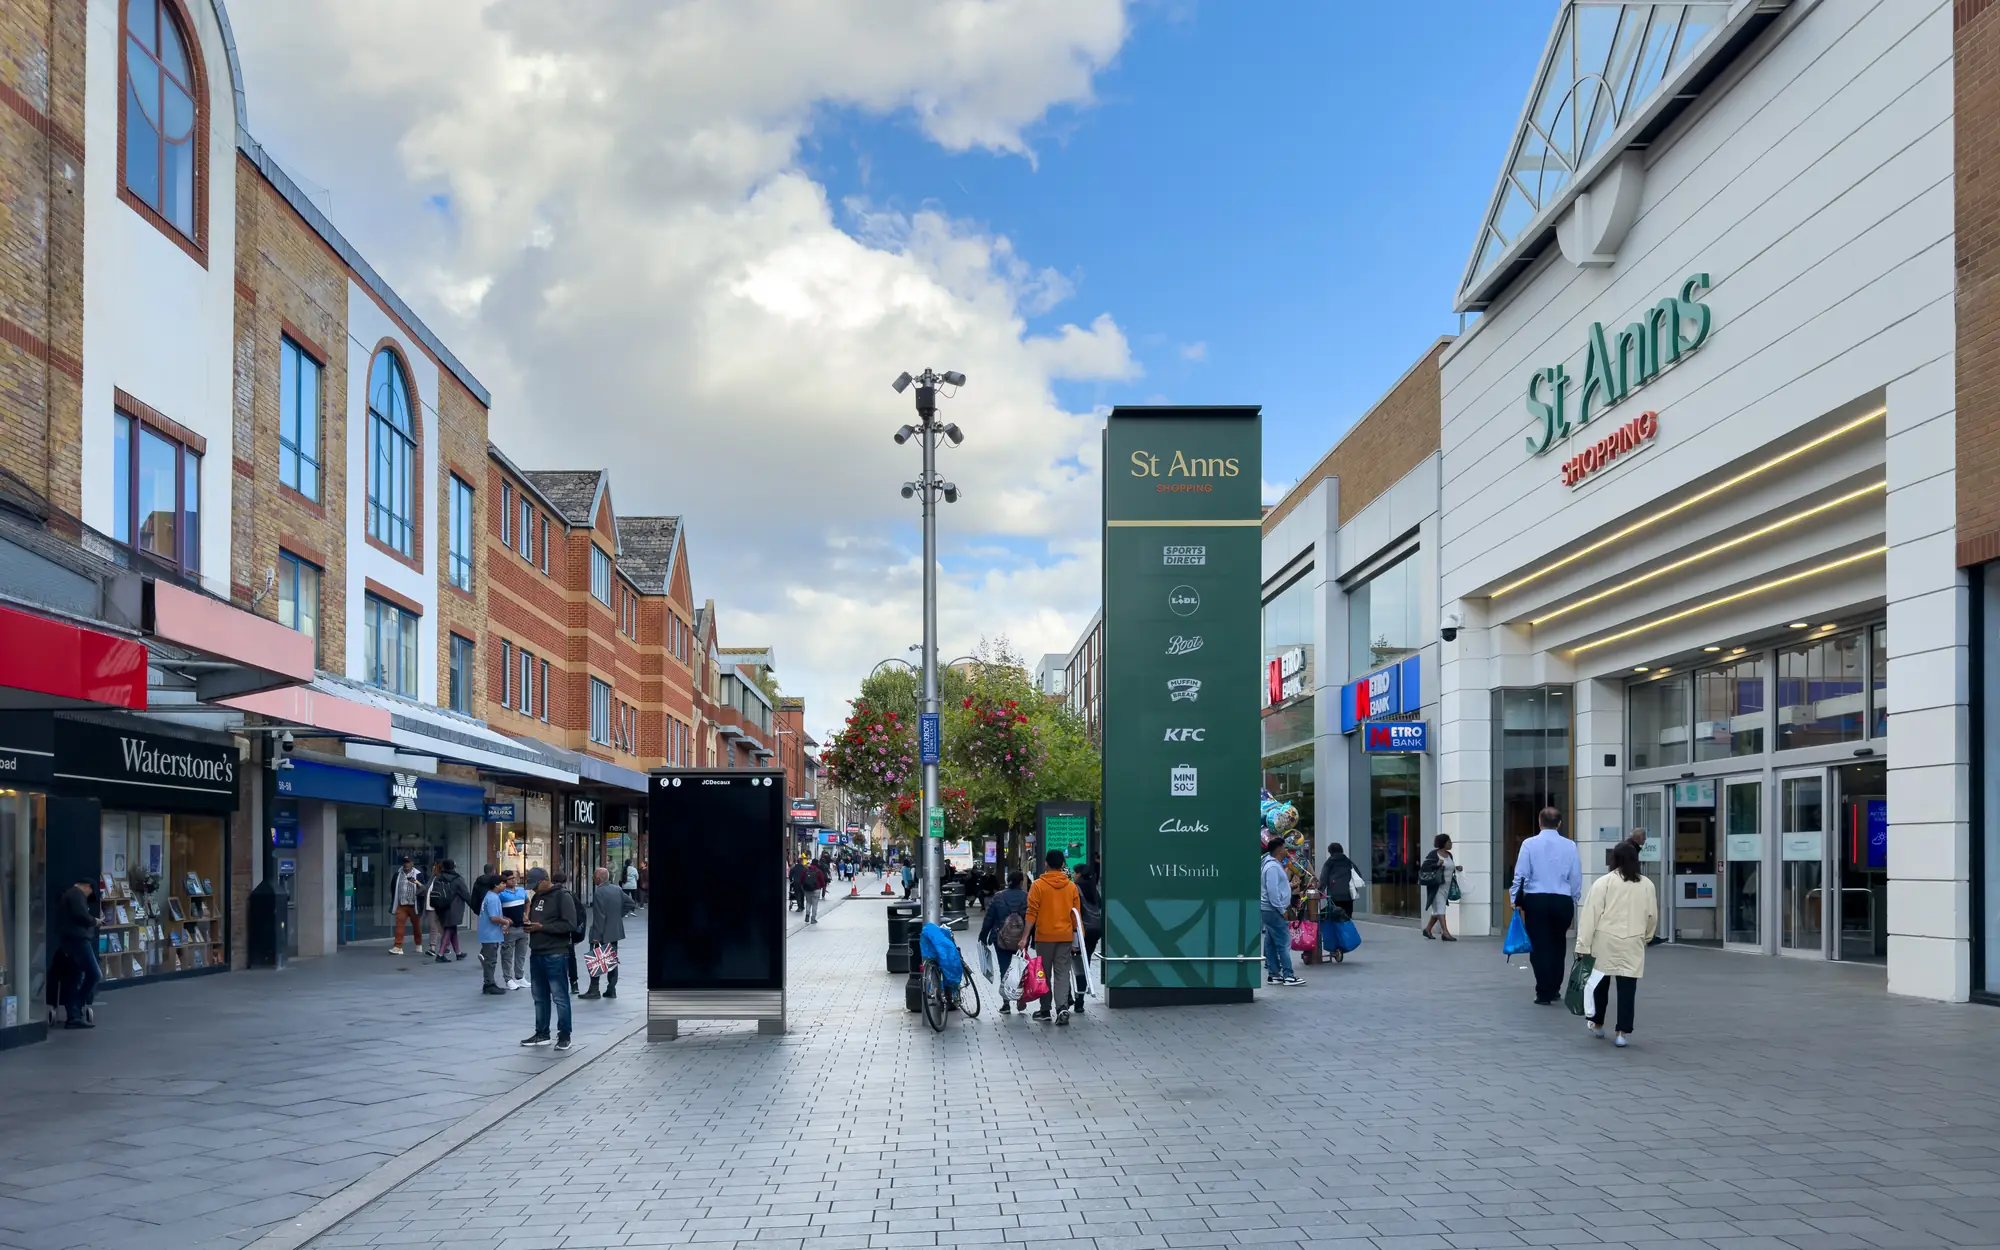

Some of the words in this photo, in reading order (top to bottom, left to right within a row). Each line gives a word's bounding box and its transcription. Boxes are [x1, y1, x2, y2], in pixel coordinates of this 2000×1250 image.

[1525, 364, 1570, 456] St
[1577, 272, 1711, 425] Anns
[1561, 410, 1659, 487] SHOPPING
[1131, 450, 1160, 478] St
[1168, 450, 1239, 478] Anns
[1156, 484, 1213, 493] SHOPPING
[1166, 547, 1203, 556] SPORTS
[1166, 556, 1203, 564] DIRECT
[1165, 635, 1204, 656] Boots
[1356, 671, 1390, 721] METRO
[1370, 696, 1390, 716] BANK
[1164, 728, 1206, 741] KFC
[1370, 727, 1423, 747] METRO
[1392, 739, 1422, 747] BANK
[120, 736, 233, 783] Waterstone's
[1173, 774, 1195, 782] MINI
[392, 784, 418, 799] HALIFAX
[574, 800, 594, 824] next
[1159, 818, 1209, 832] Clarks
[1149, 864, 1219, 877] WHSmith
